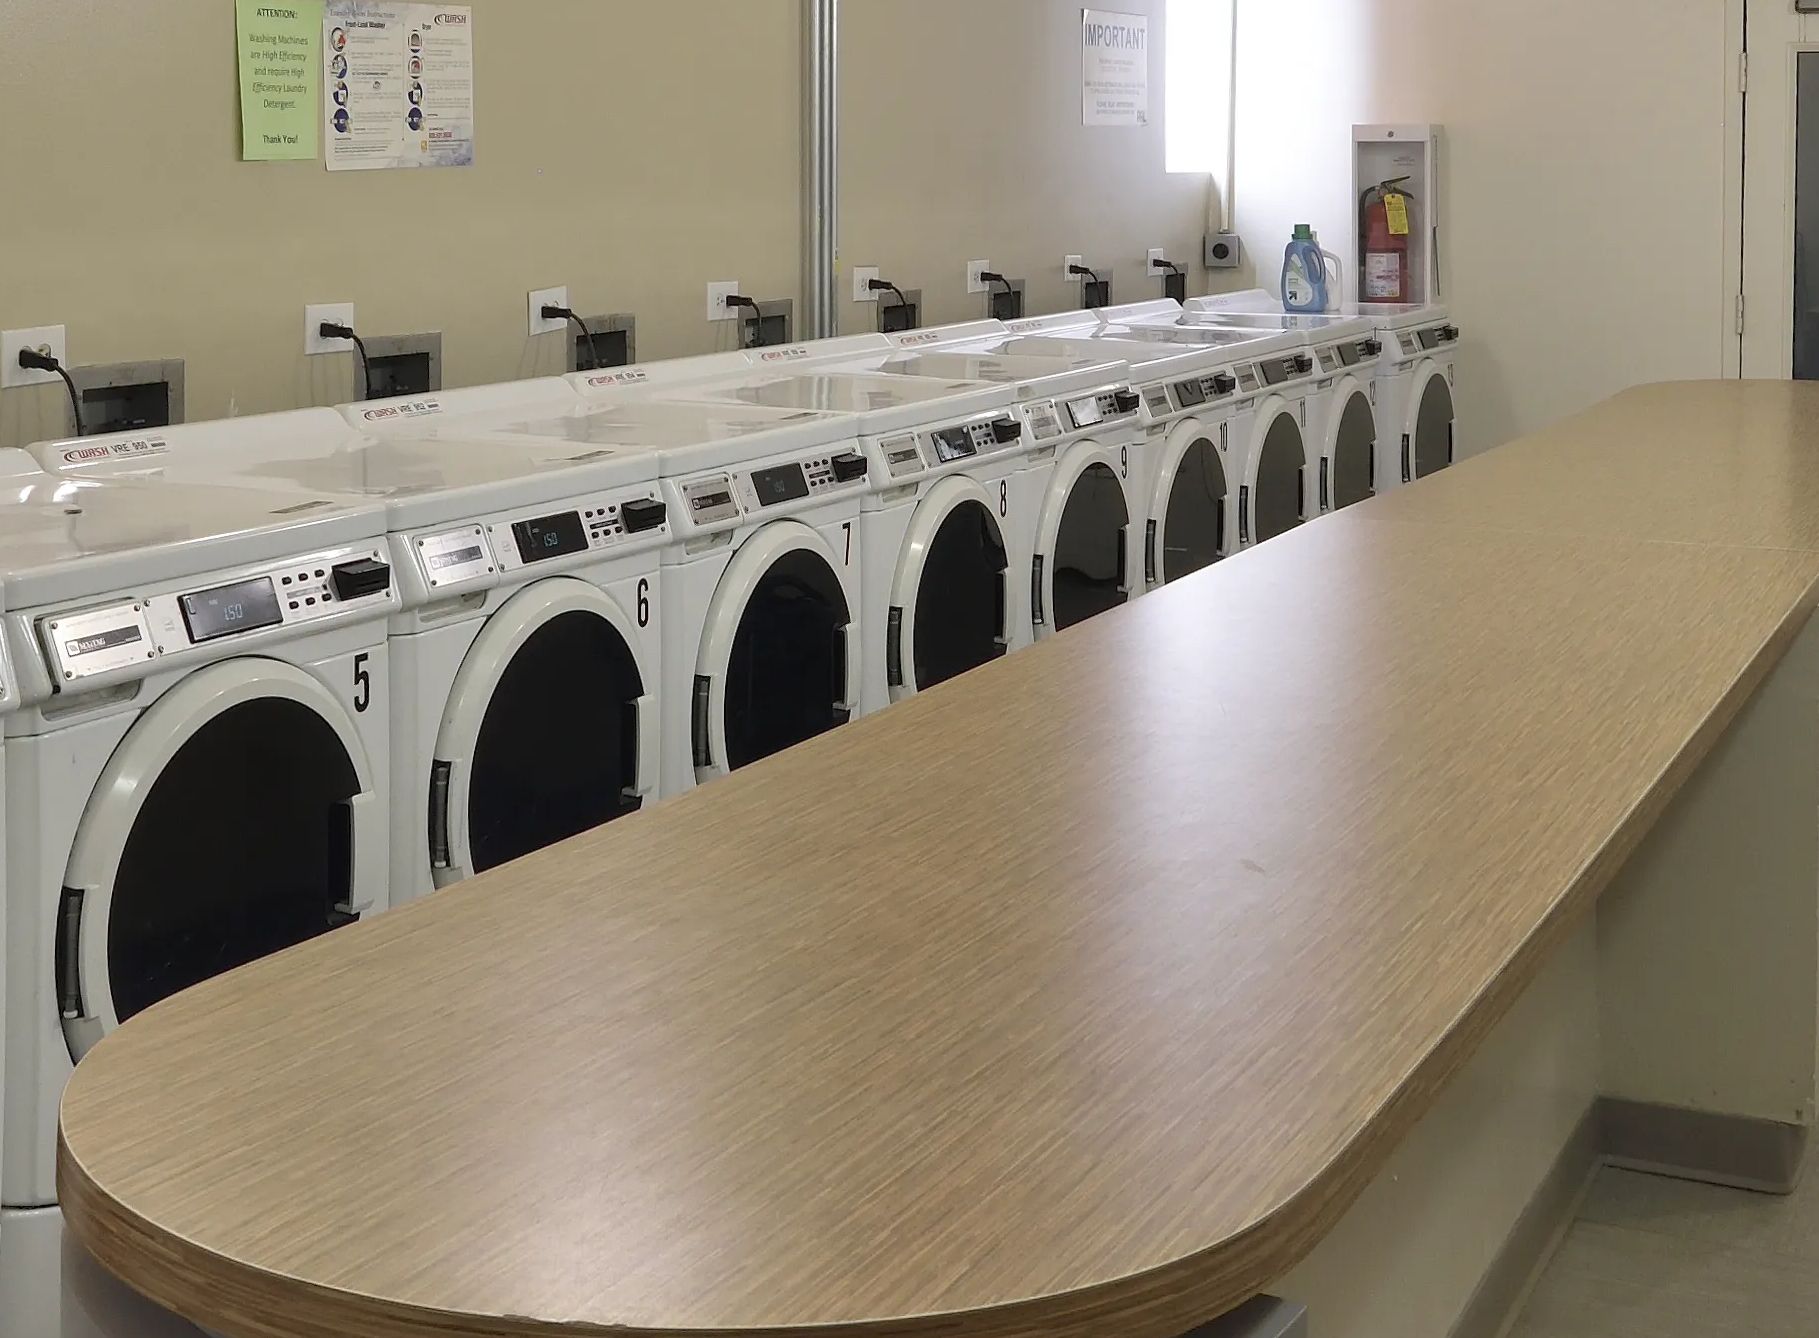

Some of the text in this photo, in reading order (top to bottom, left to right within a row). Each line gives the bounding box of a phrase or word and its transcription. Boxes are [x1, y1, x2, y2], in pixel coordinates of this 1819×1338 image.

[256, 8, 298, 19] ATTENTION:
[1084, 23, 1146, 50] IMPORTANT
[250, 50, 308, 62] are High Efficiency
[254, 67, 267, 76] and
[252, 82, 282, 94] Efficiency
[263, 134, 299, 144] Thank You!
[1299, 399, 1306, 428] 11
[1220, 421, 1228, 453] 10
[1121, 445, 1128, 479] 9
[1000, 479, 1007, 518] 8
[842, 521, 851, 566] 7
[637, 577, 650, 628] 6
[354, 651, 371, 713] 5
